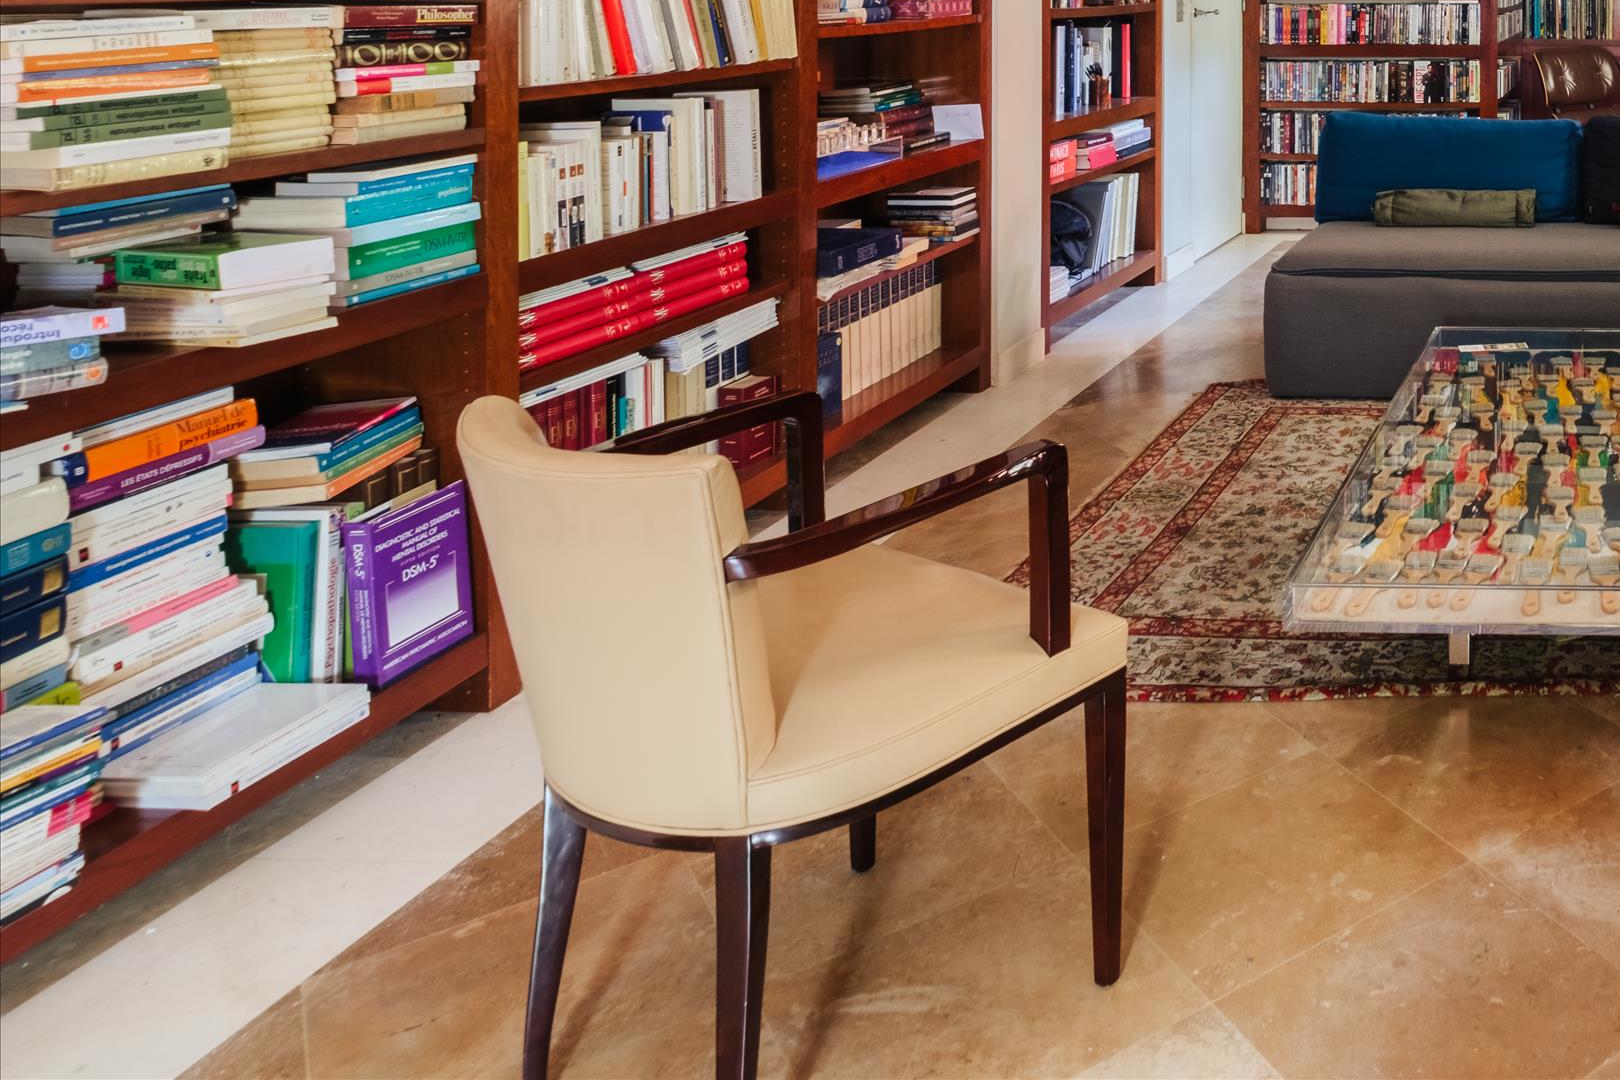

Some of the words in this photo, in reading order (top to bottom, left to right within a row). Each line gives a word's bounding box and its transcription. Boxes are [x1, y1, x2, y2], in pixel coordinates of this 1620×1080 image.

[417, 8, 474, 22] Philosopher
[100, 97, 159, 109] internationale
[161, 93, 199, 103] politique
[116, 108, 169, 120] internationale
[171, 105, 205, 115] politique
[110, 124, 166, 136] internationale
[168, 120, 201, 130] politique
[1050, 161, 1065, 177] PARIS
[176, 407, 228, 435] Manuel
[230, 404, 247, 418] de
[178, 419, 248, 451] psychiatrie
[120, 475, 135, 488] LES
[135, 467, 159, 483] ÉTATS
[159, 453, 204, 475] DÉPRESSIFS
[375, 531, 414, 553] DIAGNOSTIC
[414, 524, 429, 535] AND
[429, 507, 460, 529] STATISTICAL
[401, 533, 427, 550] MANUAL
[428, 526, 438, 538] OF
[392, 546, 417, 563] MENTAL
[417, 530, 448, 552] DISORDERS
[325, 557, 338, 670] Psychopathologie
